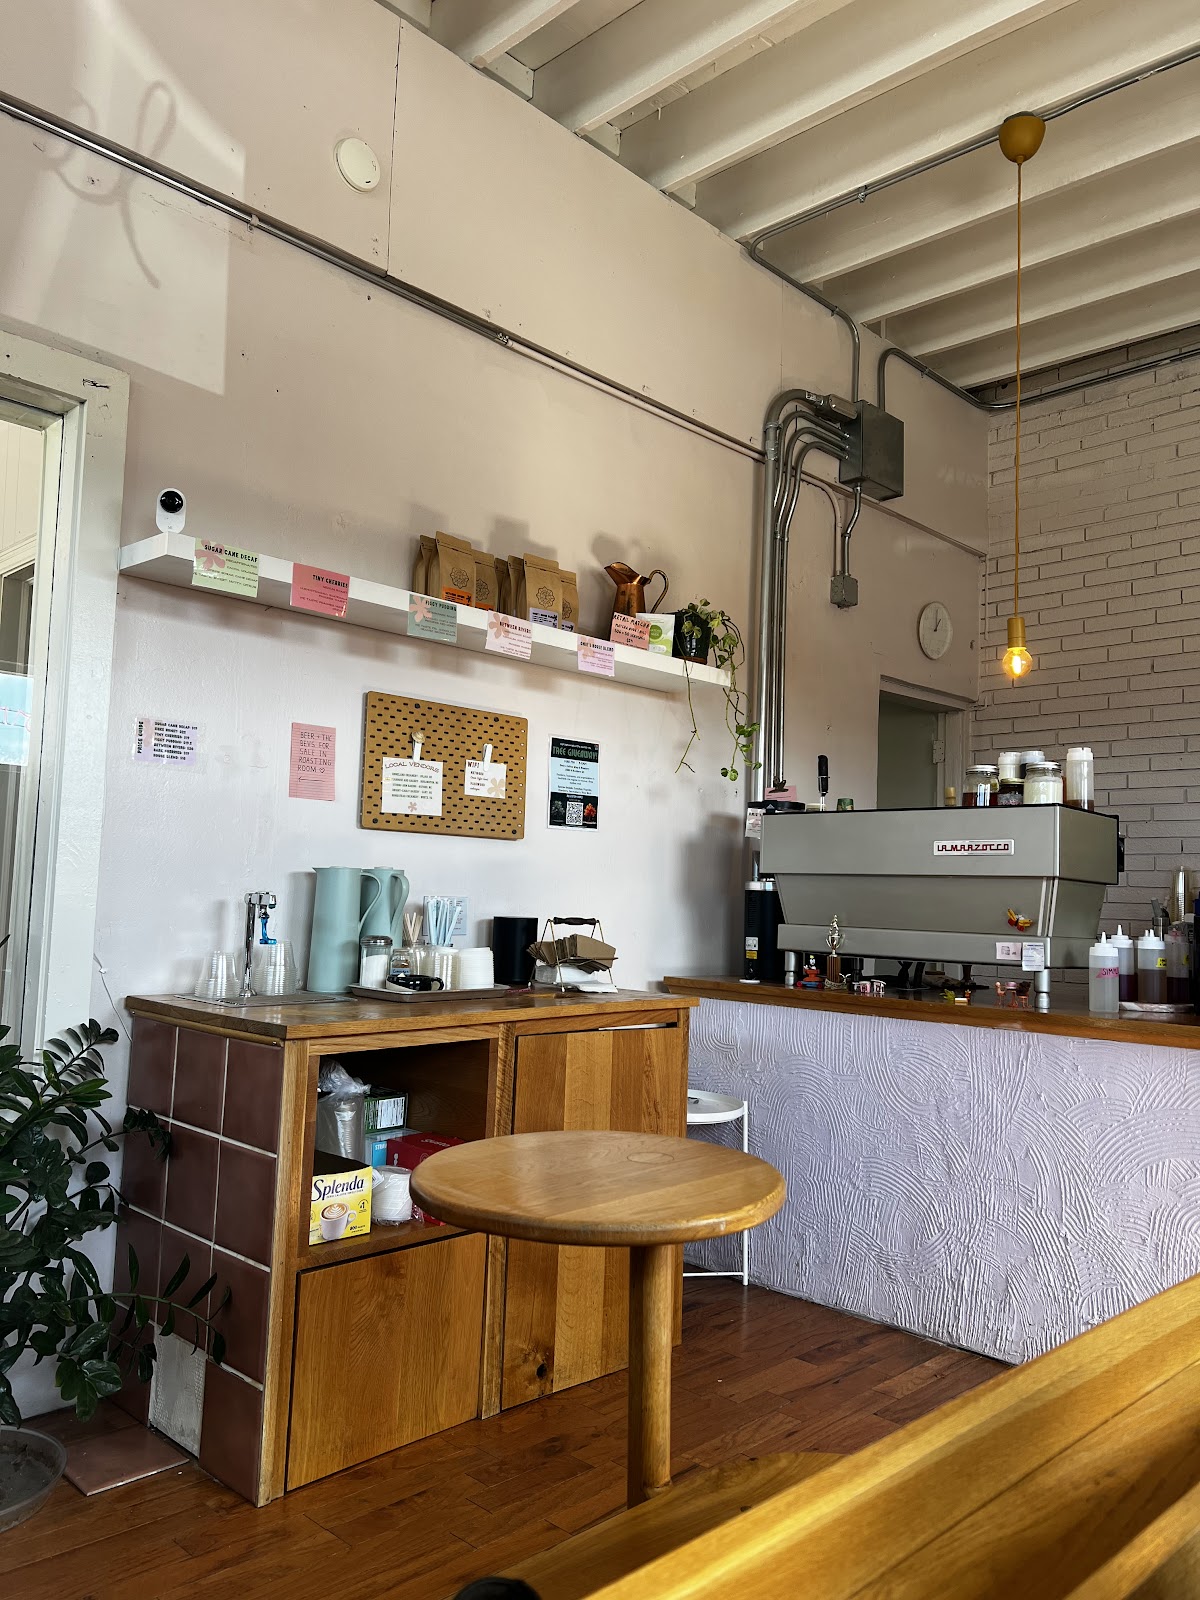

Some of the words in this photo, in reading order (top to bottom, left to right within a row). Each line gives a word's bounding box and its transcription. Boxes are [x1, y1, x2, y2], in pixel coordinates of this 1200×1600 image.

[204, 544, 223, 554] SUGAR
[224, 550, 239, 559] CANE
[240, 554, 258, 563] DECAF
[326, 578, 348, 588] CHERRIES
[300, 732, 314, 740] BEER
[322, 734, 332, 742] THE
[300, 740, 316, 748] BEVS
[318, 742, 330, 750] FOR
[300, 748, 315, 756] SALE
[320, 750, 327, 758] IN
[552, 746, 566, 756] TREE
[568, 748, 598, 760] GIVEAWAY!
[298, 757, 332, 766] ROASTING
[298, 765, 317, 773] ROOM
[408, 762, 440, 774] VENDORS
[311, 1176, 364, 1202] Splenda
